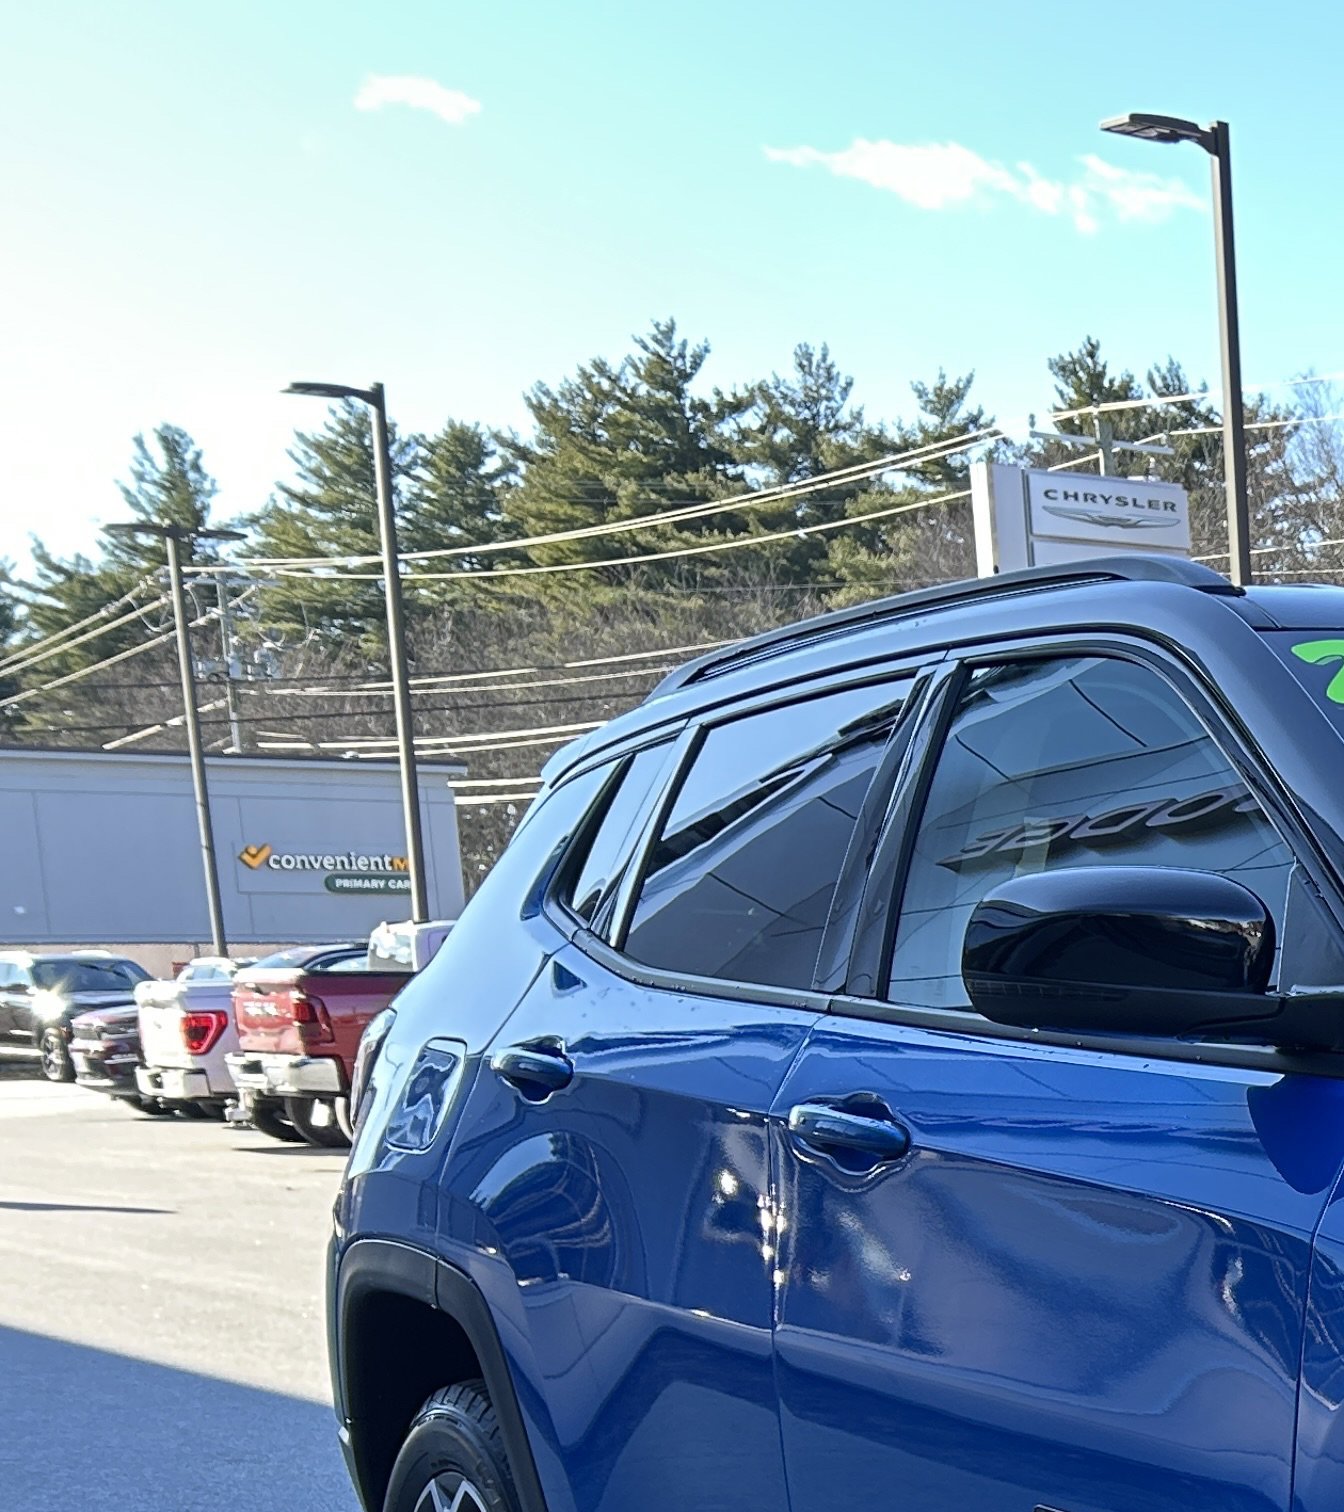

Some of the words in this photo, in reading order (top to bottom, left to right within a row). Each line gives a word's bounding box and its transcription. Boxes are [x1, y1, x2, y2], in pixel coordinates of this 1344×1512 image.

[1043, 488, 1177, 512] CHRYSLER
[268, 851, 410, 872] convenientM
[335, 879, 385, 889] PRIMARY
[388, 879, 412, 889] CAR
